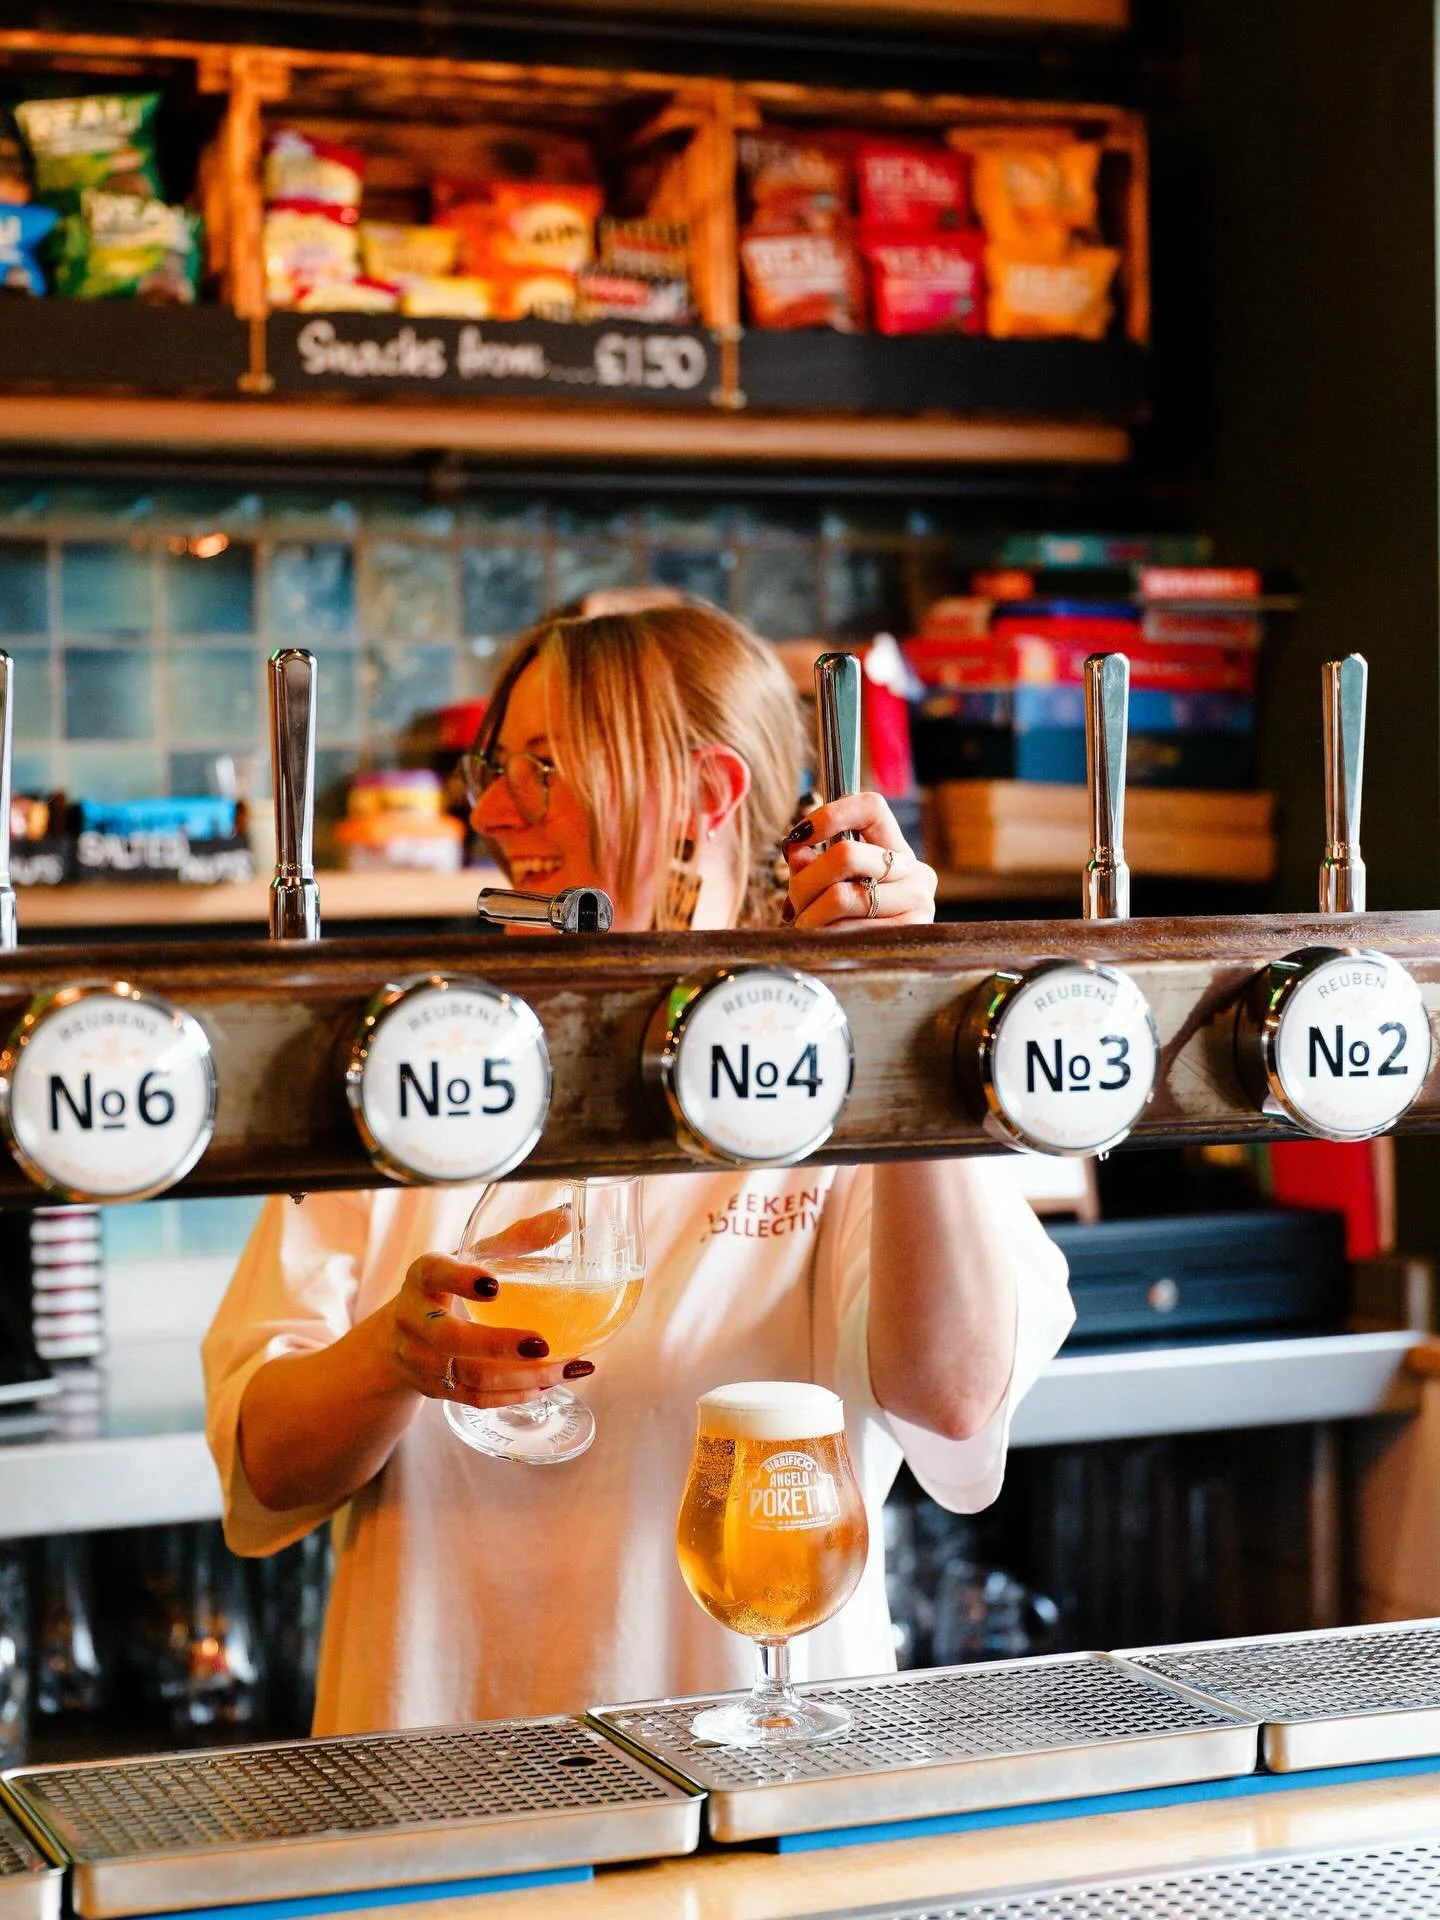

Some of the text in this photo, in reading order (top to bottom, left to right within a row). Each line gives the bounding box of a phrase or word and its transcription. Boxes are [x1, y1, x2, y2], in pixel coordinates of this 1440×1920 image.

[298, 319, 448, 378] Snacks
[1317, 972, 1388, 999] REUBEN
[764, 1455, 813, 1473] BIRRIFICIO
[769, 1470, 810, 1487] ANGELO
